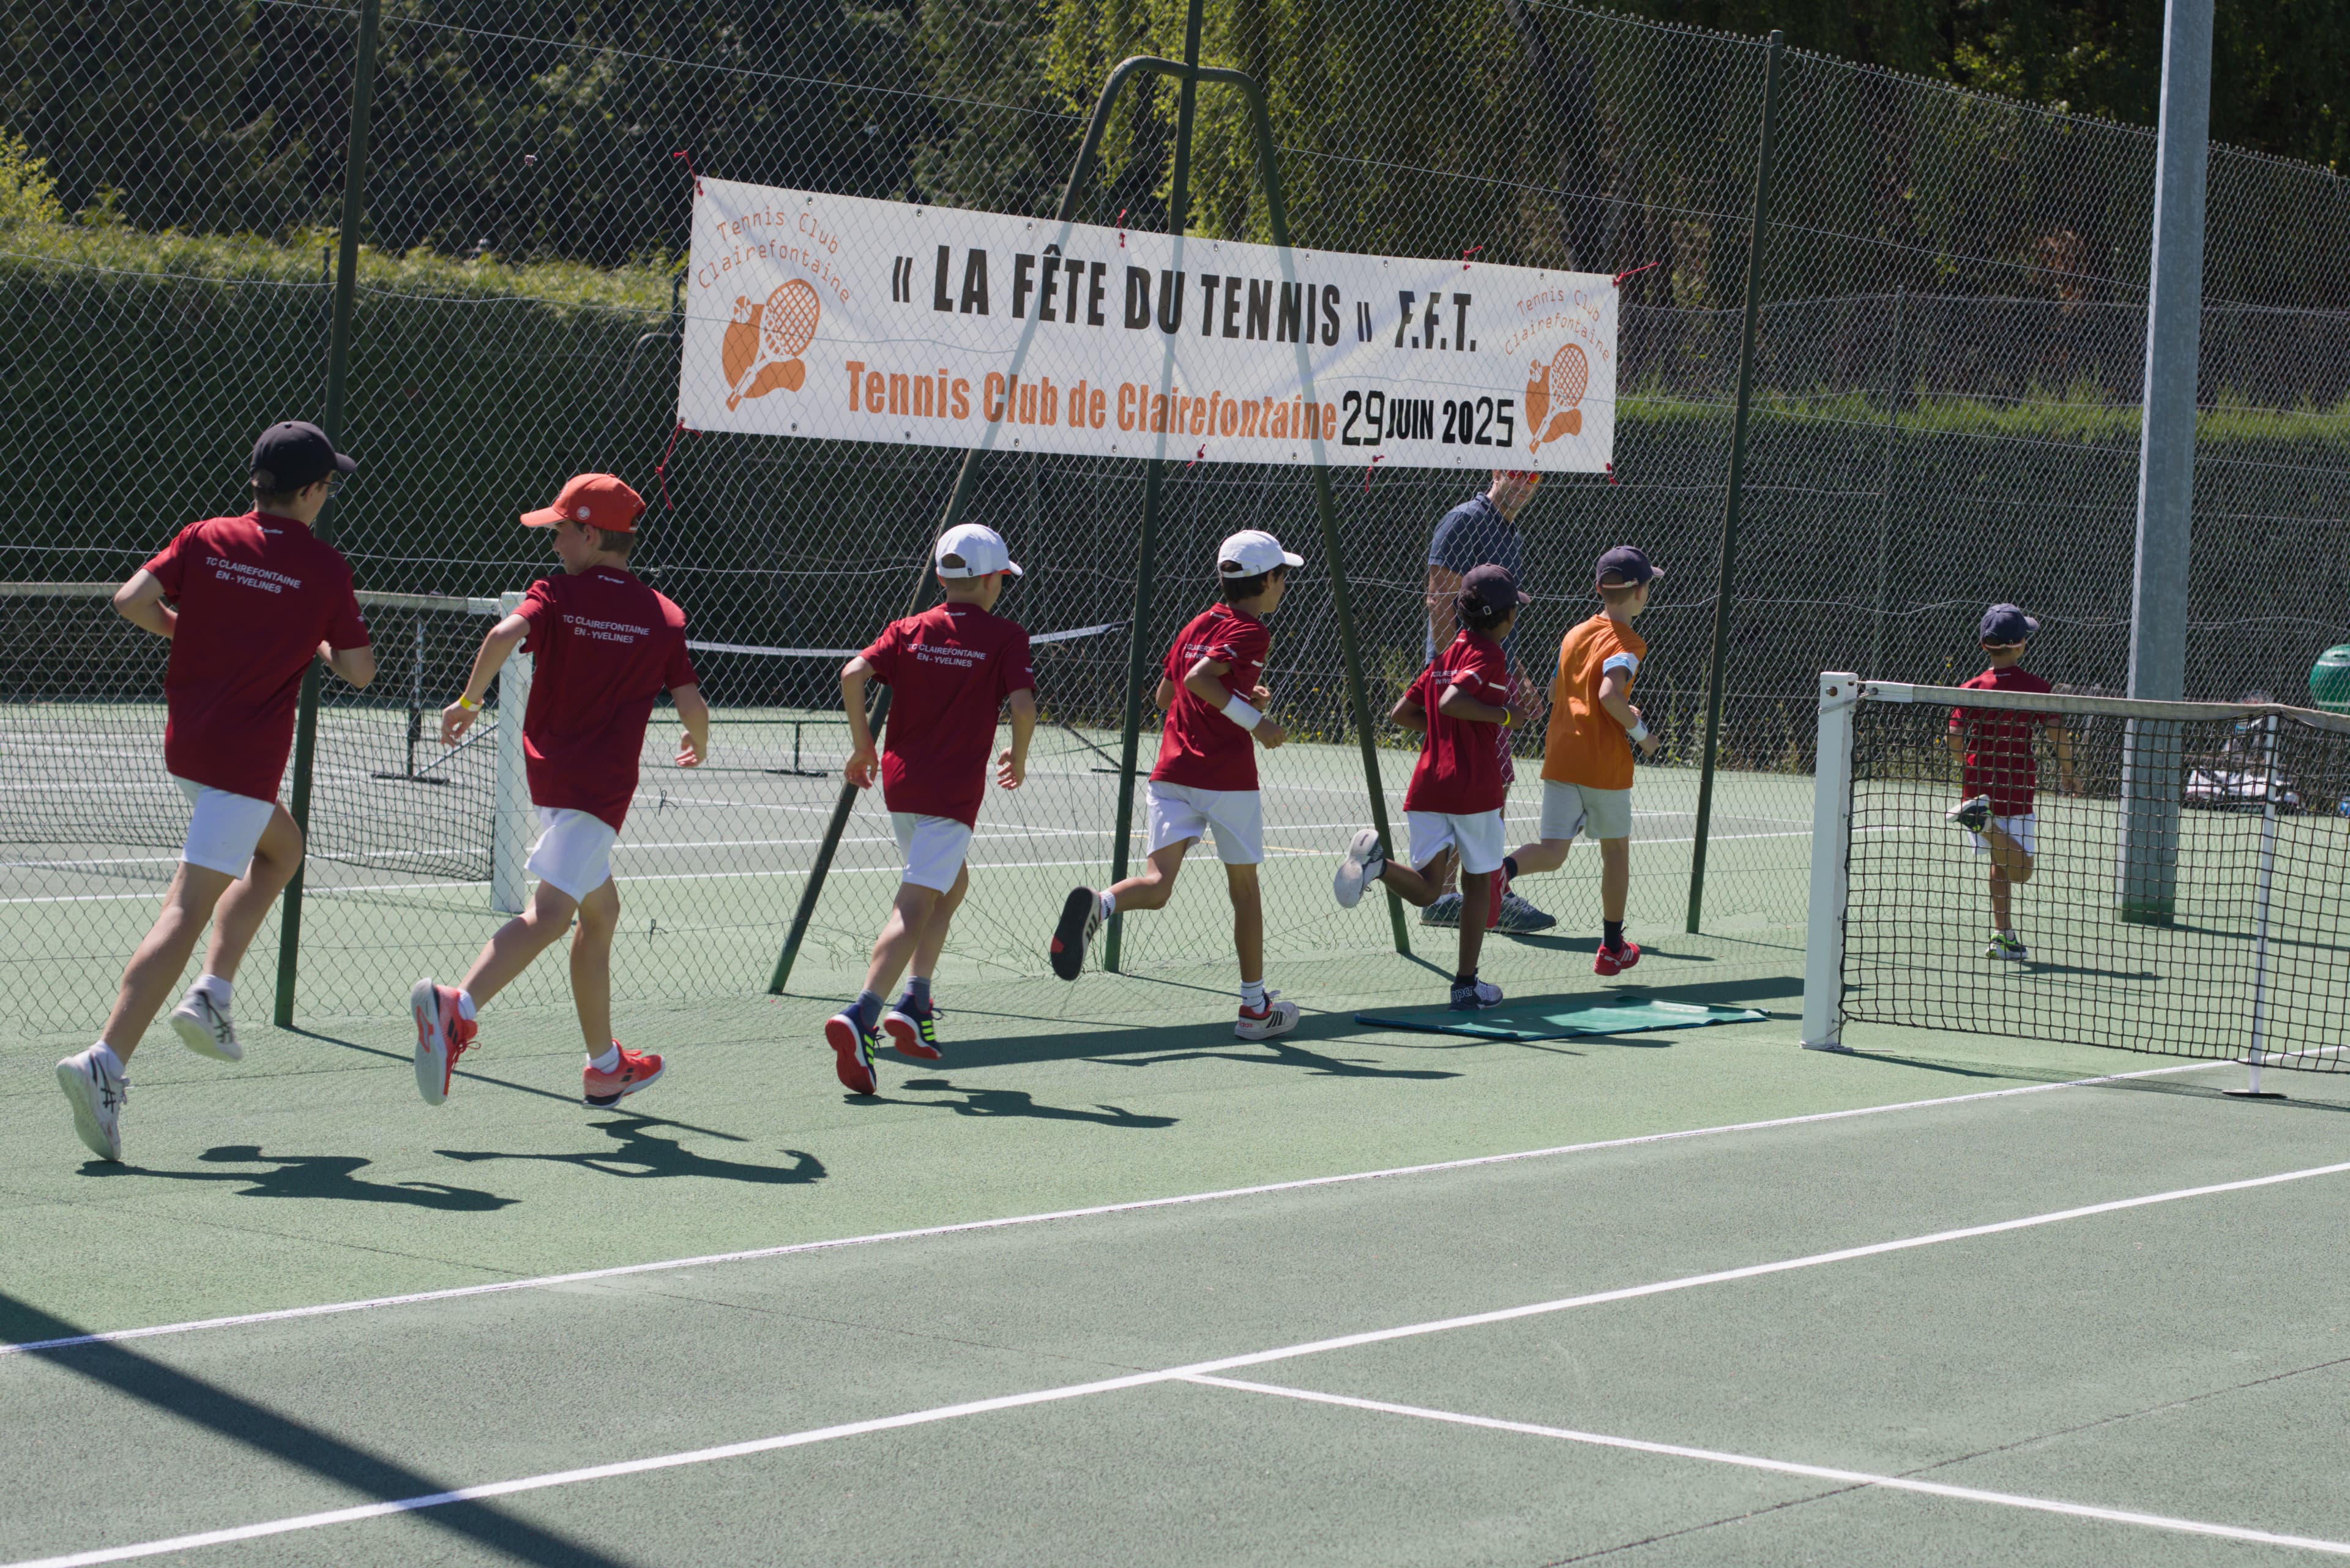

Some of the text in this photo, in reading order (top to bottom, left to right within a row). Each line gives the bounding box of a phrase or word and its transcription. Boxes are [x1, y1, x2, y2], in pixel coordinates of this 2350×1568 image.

[717, 206, 838, 254] Tennis Club
[698, 239, 849, 304] Clairefontaine
[933, 244, 990, 316] LA
[1012, 244, 1107, 326] FÊTE
[1124, 265, 1185, 335] DU
[1201, 273, 1340, 346] TENNIS
[1394, 290, 1477, 352] F.F.T.
[1517, 285, 1600, 322] Tennis Club
[1505, 313, 1610, 362] Clairefontaine
[845, 360, 1514, 447] Tennis Club de Clairefontaine 29 JUIN 2025
[206, 556, 302, 589] TC CLAIREFONTAINE
[215, 570, 230, 581] EN
[236, 575, 283, 594] YVELINES
[562, 614, 651, 635] TC CLAIREFONTAINE
[574, 627, 586, 637] EN
[592, 630, 634, 643] YVELINES
[917, 652, 929, 662] EN
[934, 657, 973, 668] YVELINES
[919, 644, 987, 660] CLAIREFONTAINE
